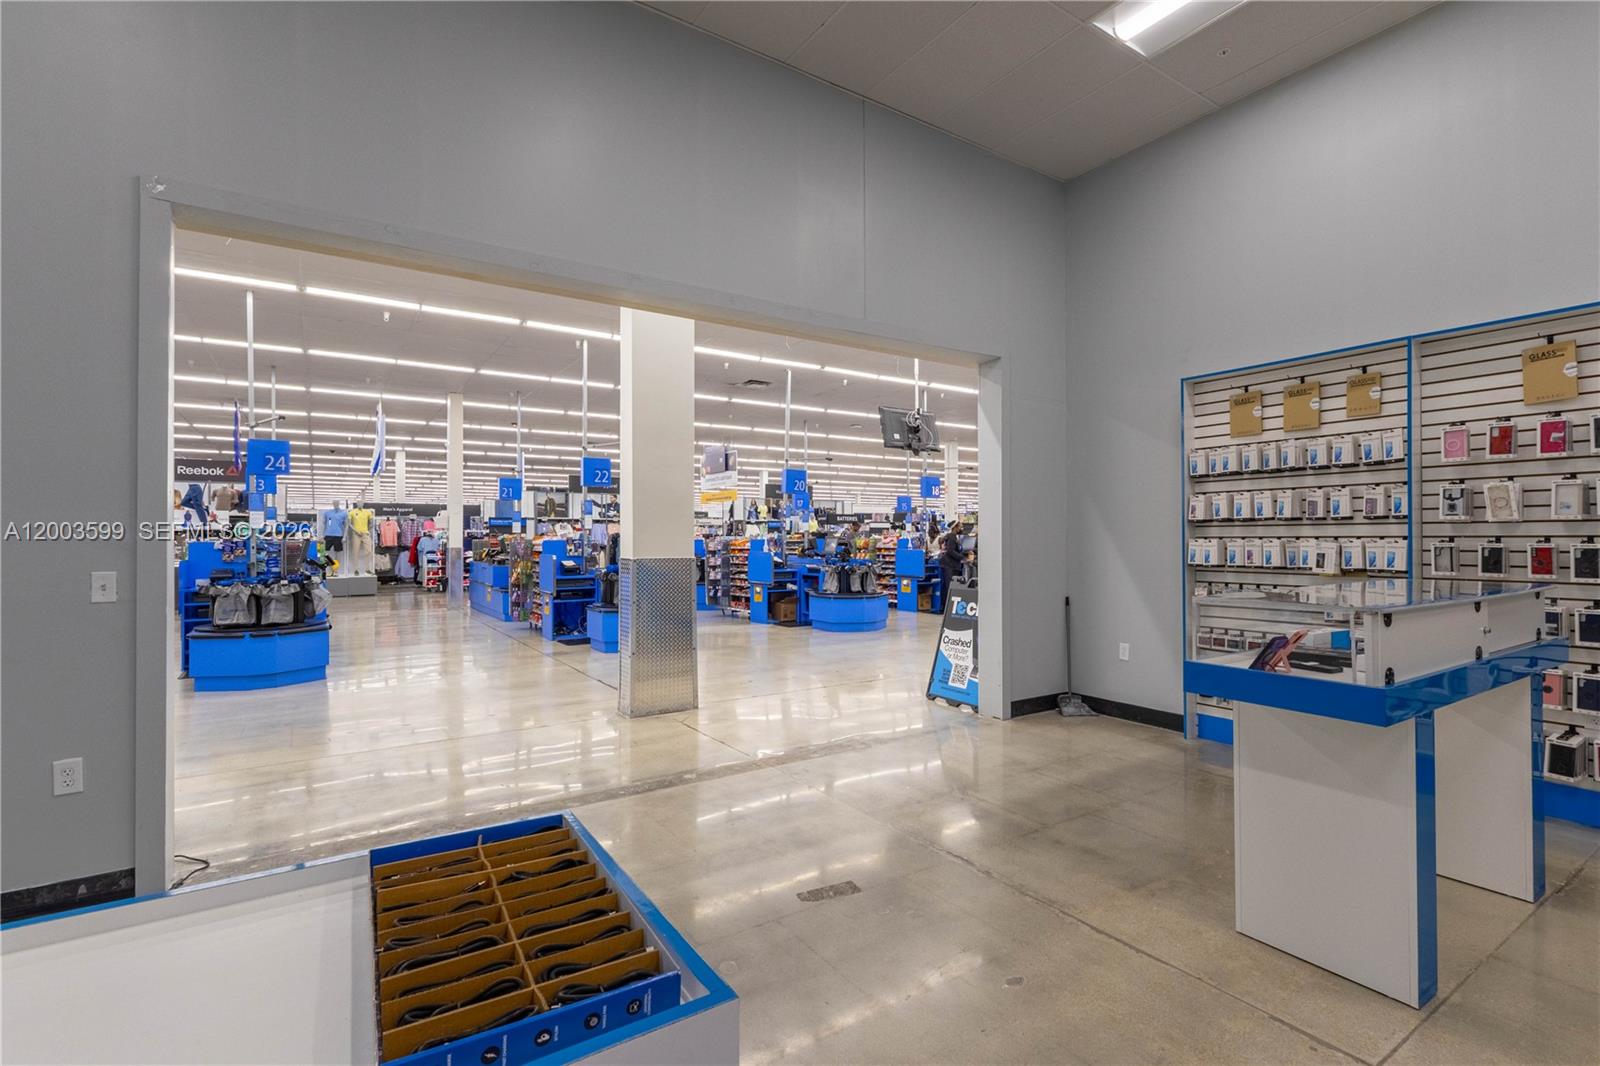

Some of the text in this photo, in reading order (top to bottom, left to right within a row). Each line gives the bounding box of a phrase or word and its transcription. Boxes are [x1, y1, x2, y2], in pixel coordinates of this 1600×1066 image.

[264, 455, 286, 471] 24
[177, 465, 225, 477] Reebok
[594, 470, 609, 483] 22
[794, 479, 805, 491] 20
[931, 485, 940, 496] 18
[501, 487, 513, 498] 21
[943, 636, 972, 648] Crashed
[944, 644, 969, 655] Computer
